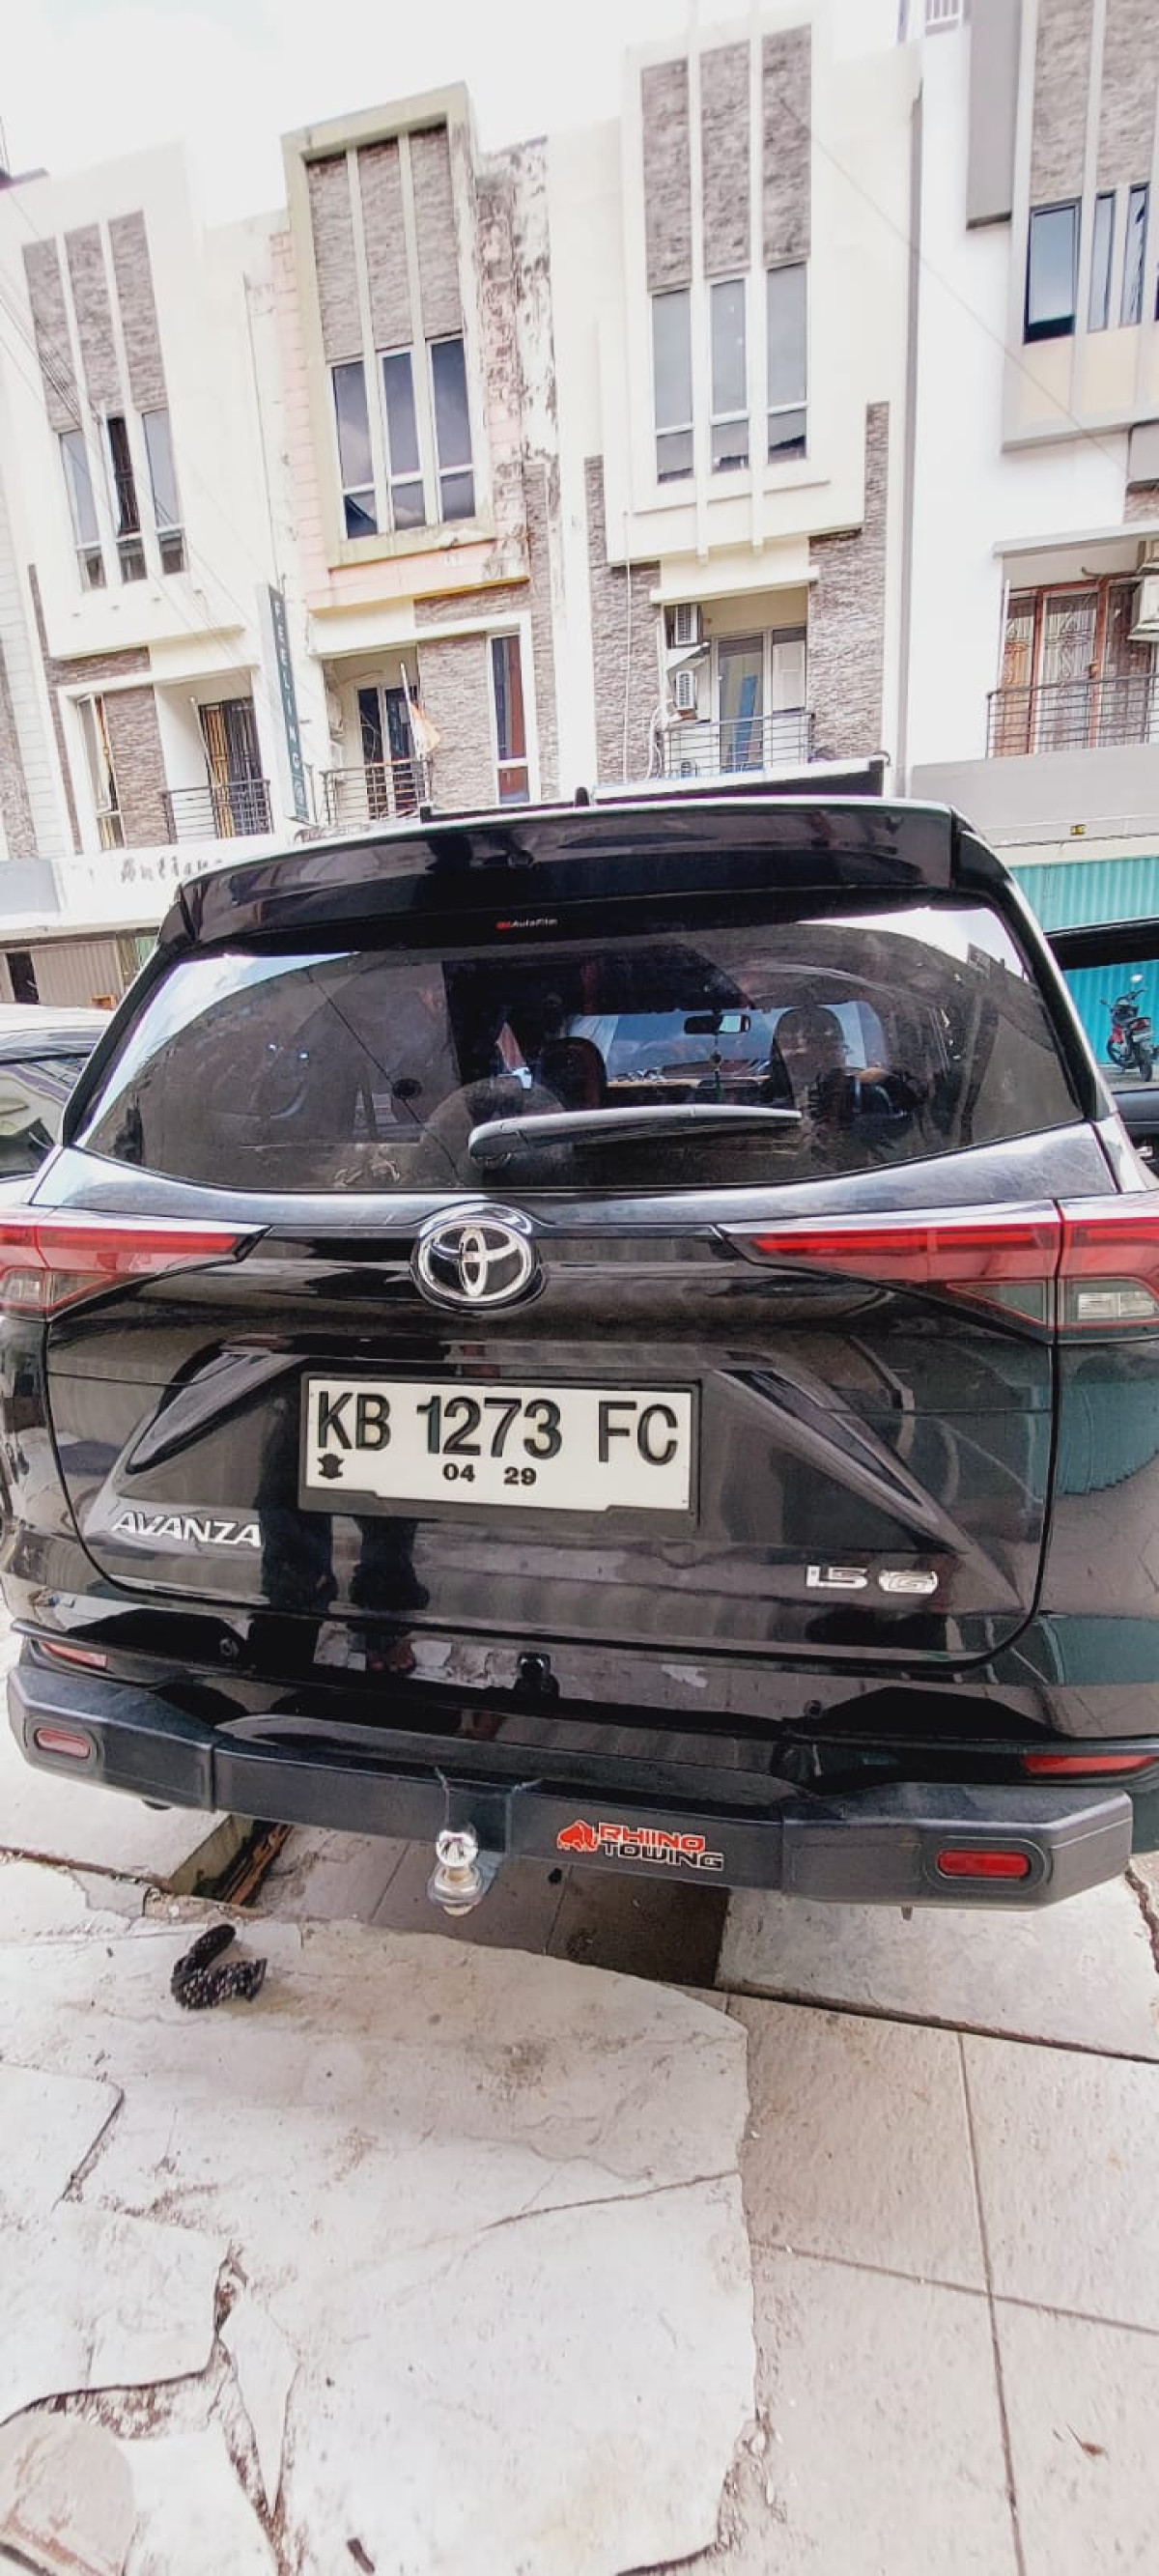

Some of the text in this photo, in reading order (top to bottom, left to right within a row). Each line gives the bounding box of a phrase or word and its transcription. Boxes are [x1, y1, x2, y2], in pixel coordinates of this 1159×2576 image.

[317, 1391, 678, 1466] KB 1273 FC
[442, 1462, 537, 1486] 04 29
[110, 1510, 262, 1548] AVANZA
[600, 1840, 724, 1872] TOWING
